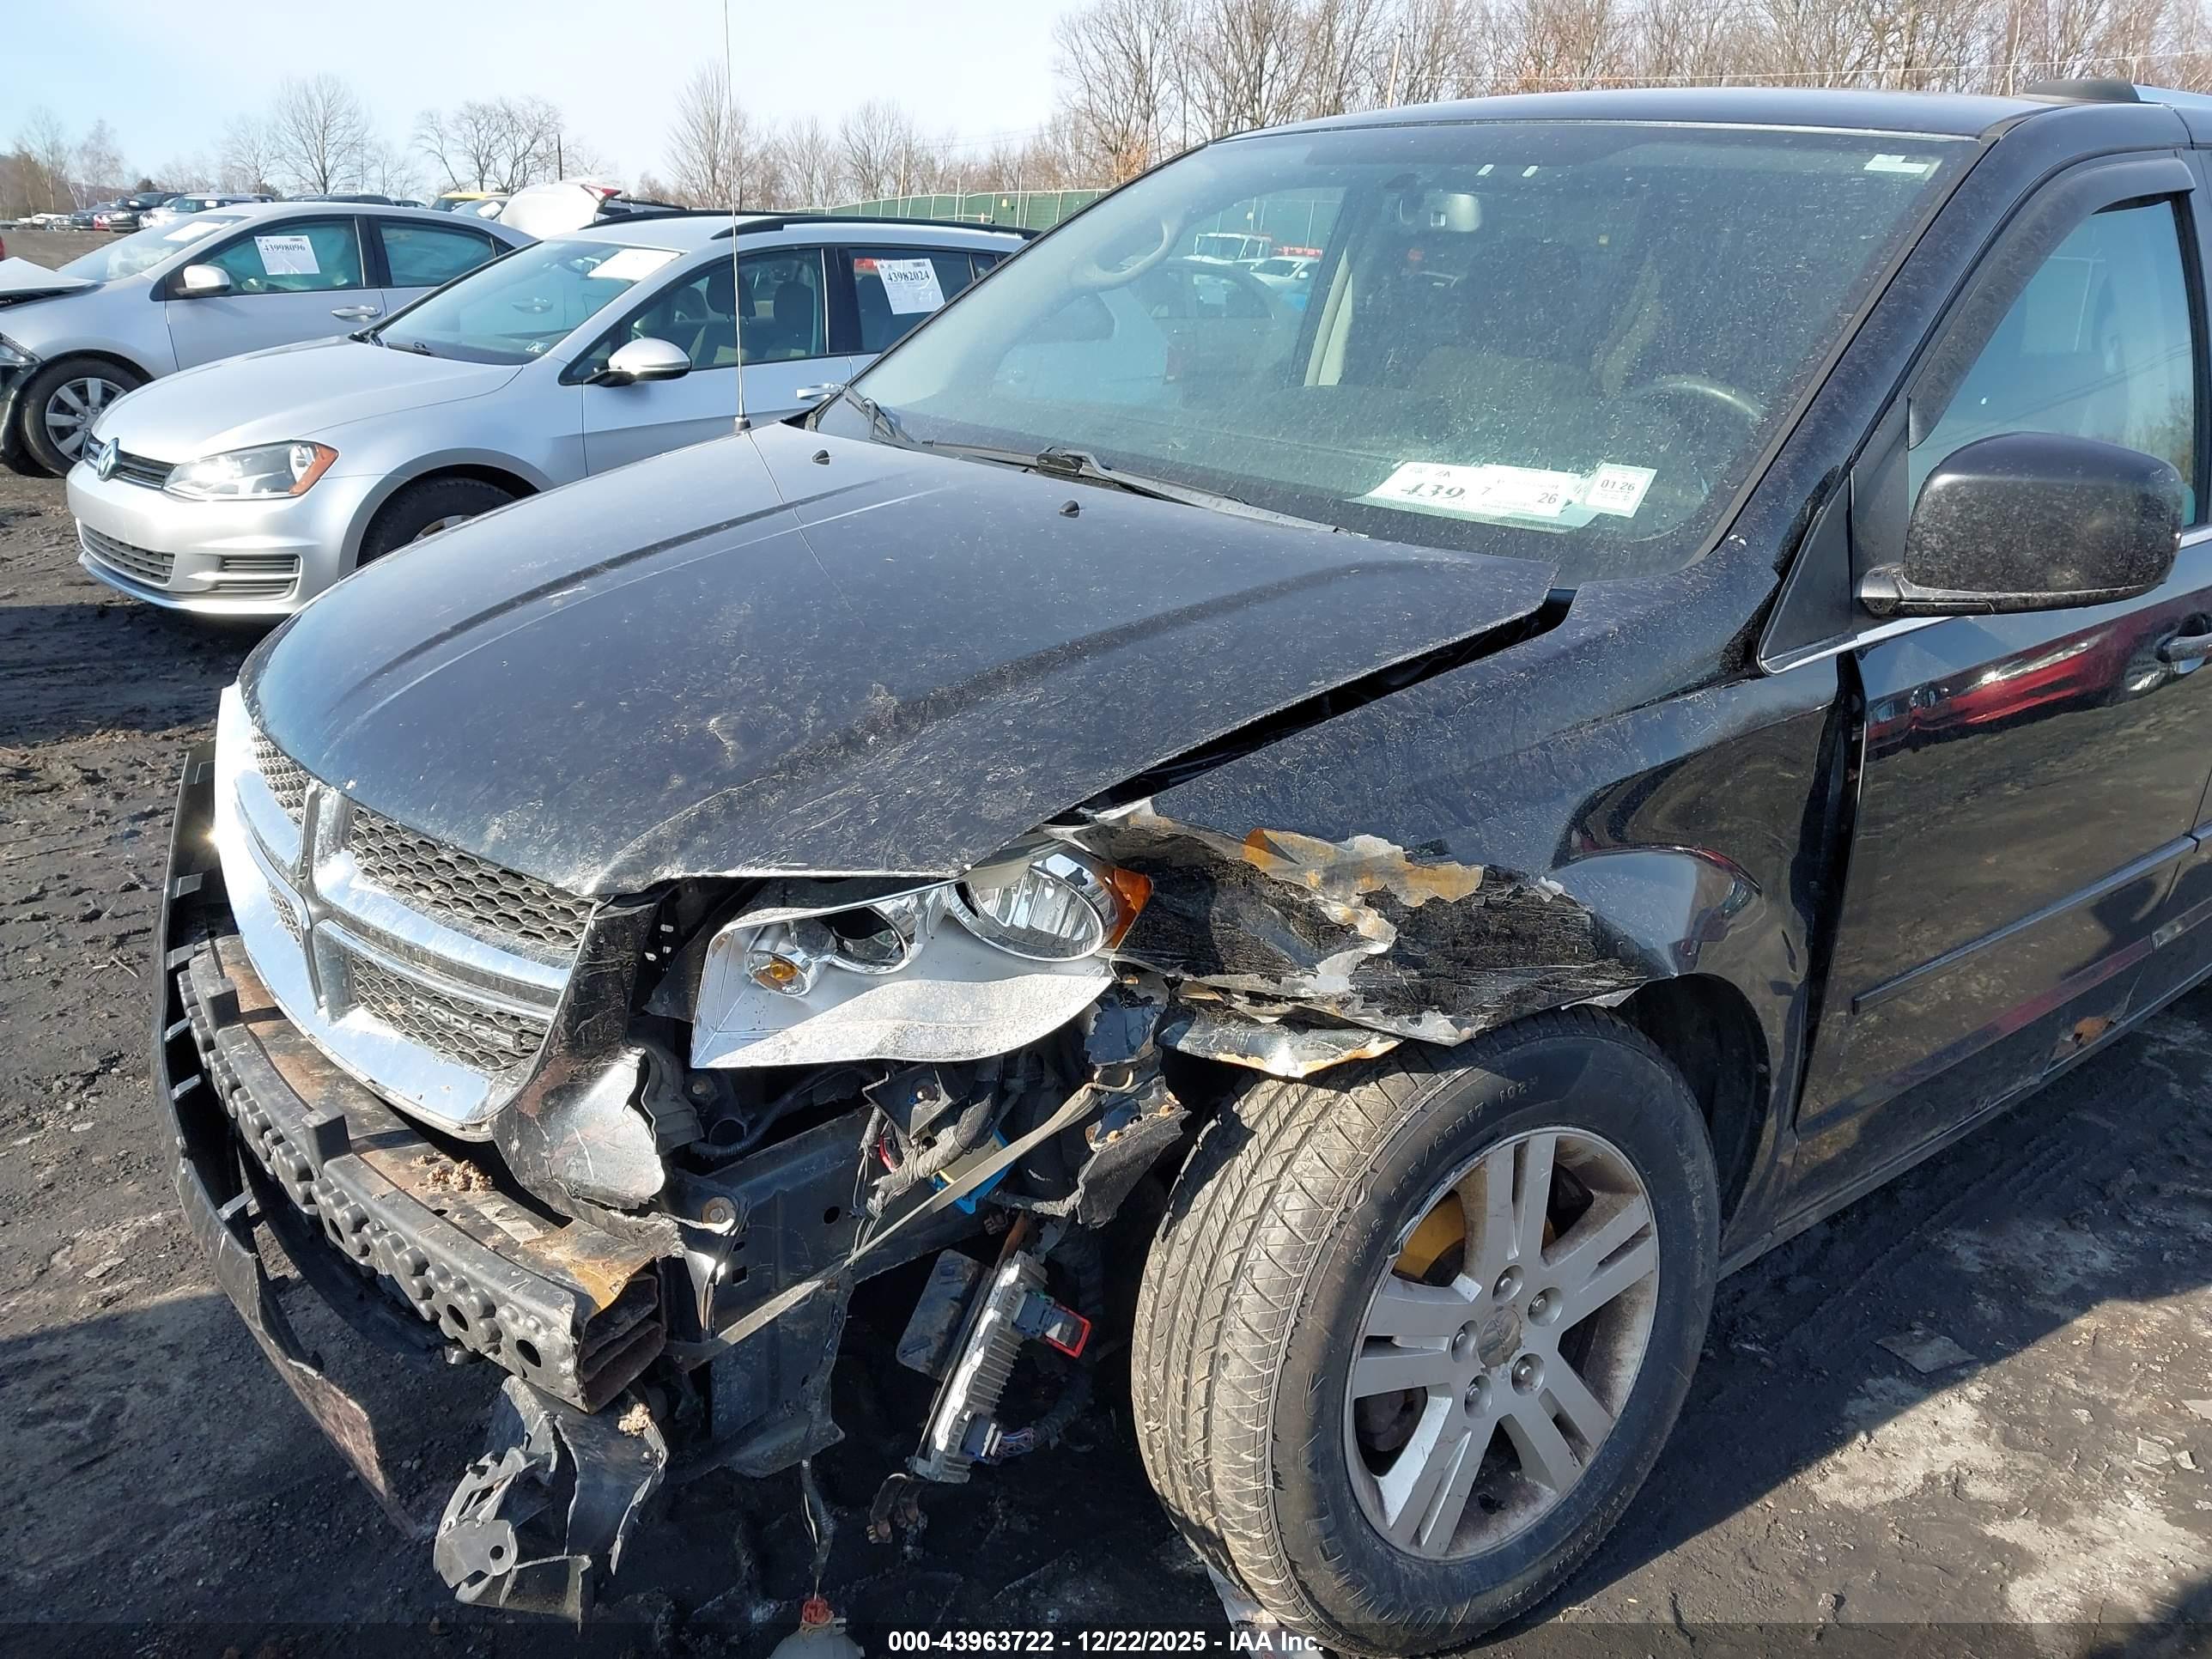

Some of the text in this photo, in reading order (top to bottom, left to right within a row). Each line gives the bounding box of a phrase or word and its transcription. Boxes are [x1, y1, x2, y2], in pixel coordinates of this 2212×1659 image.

[887, 269, 930, 283] 43982024
[1620, 481, 1636, 491] 26
[1537, 491, 1559, 505] 26
[410, 995, 514, 1049] DODGE
